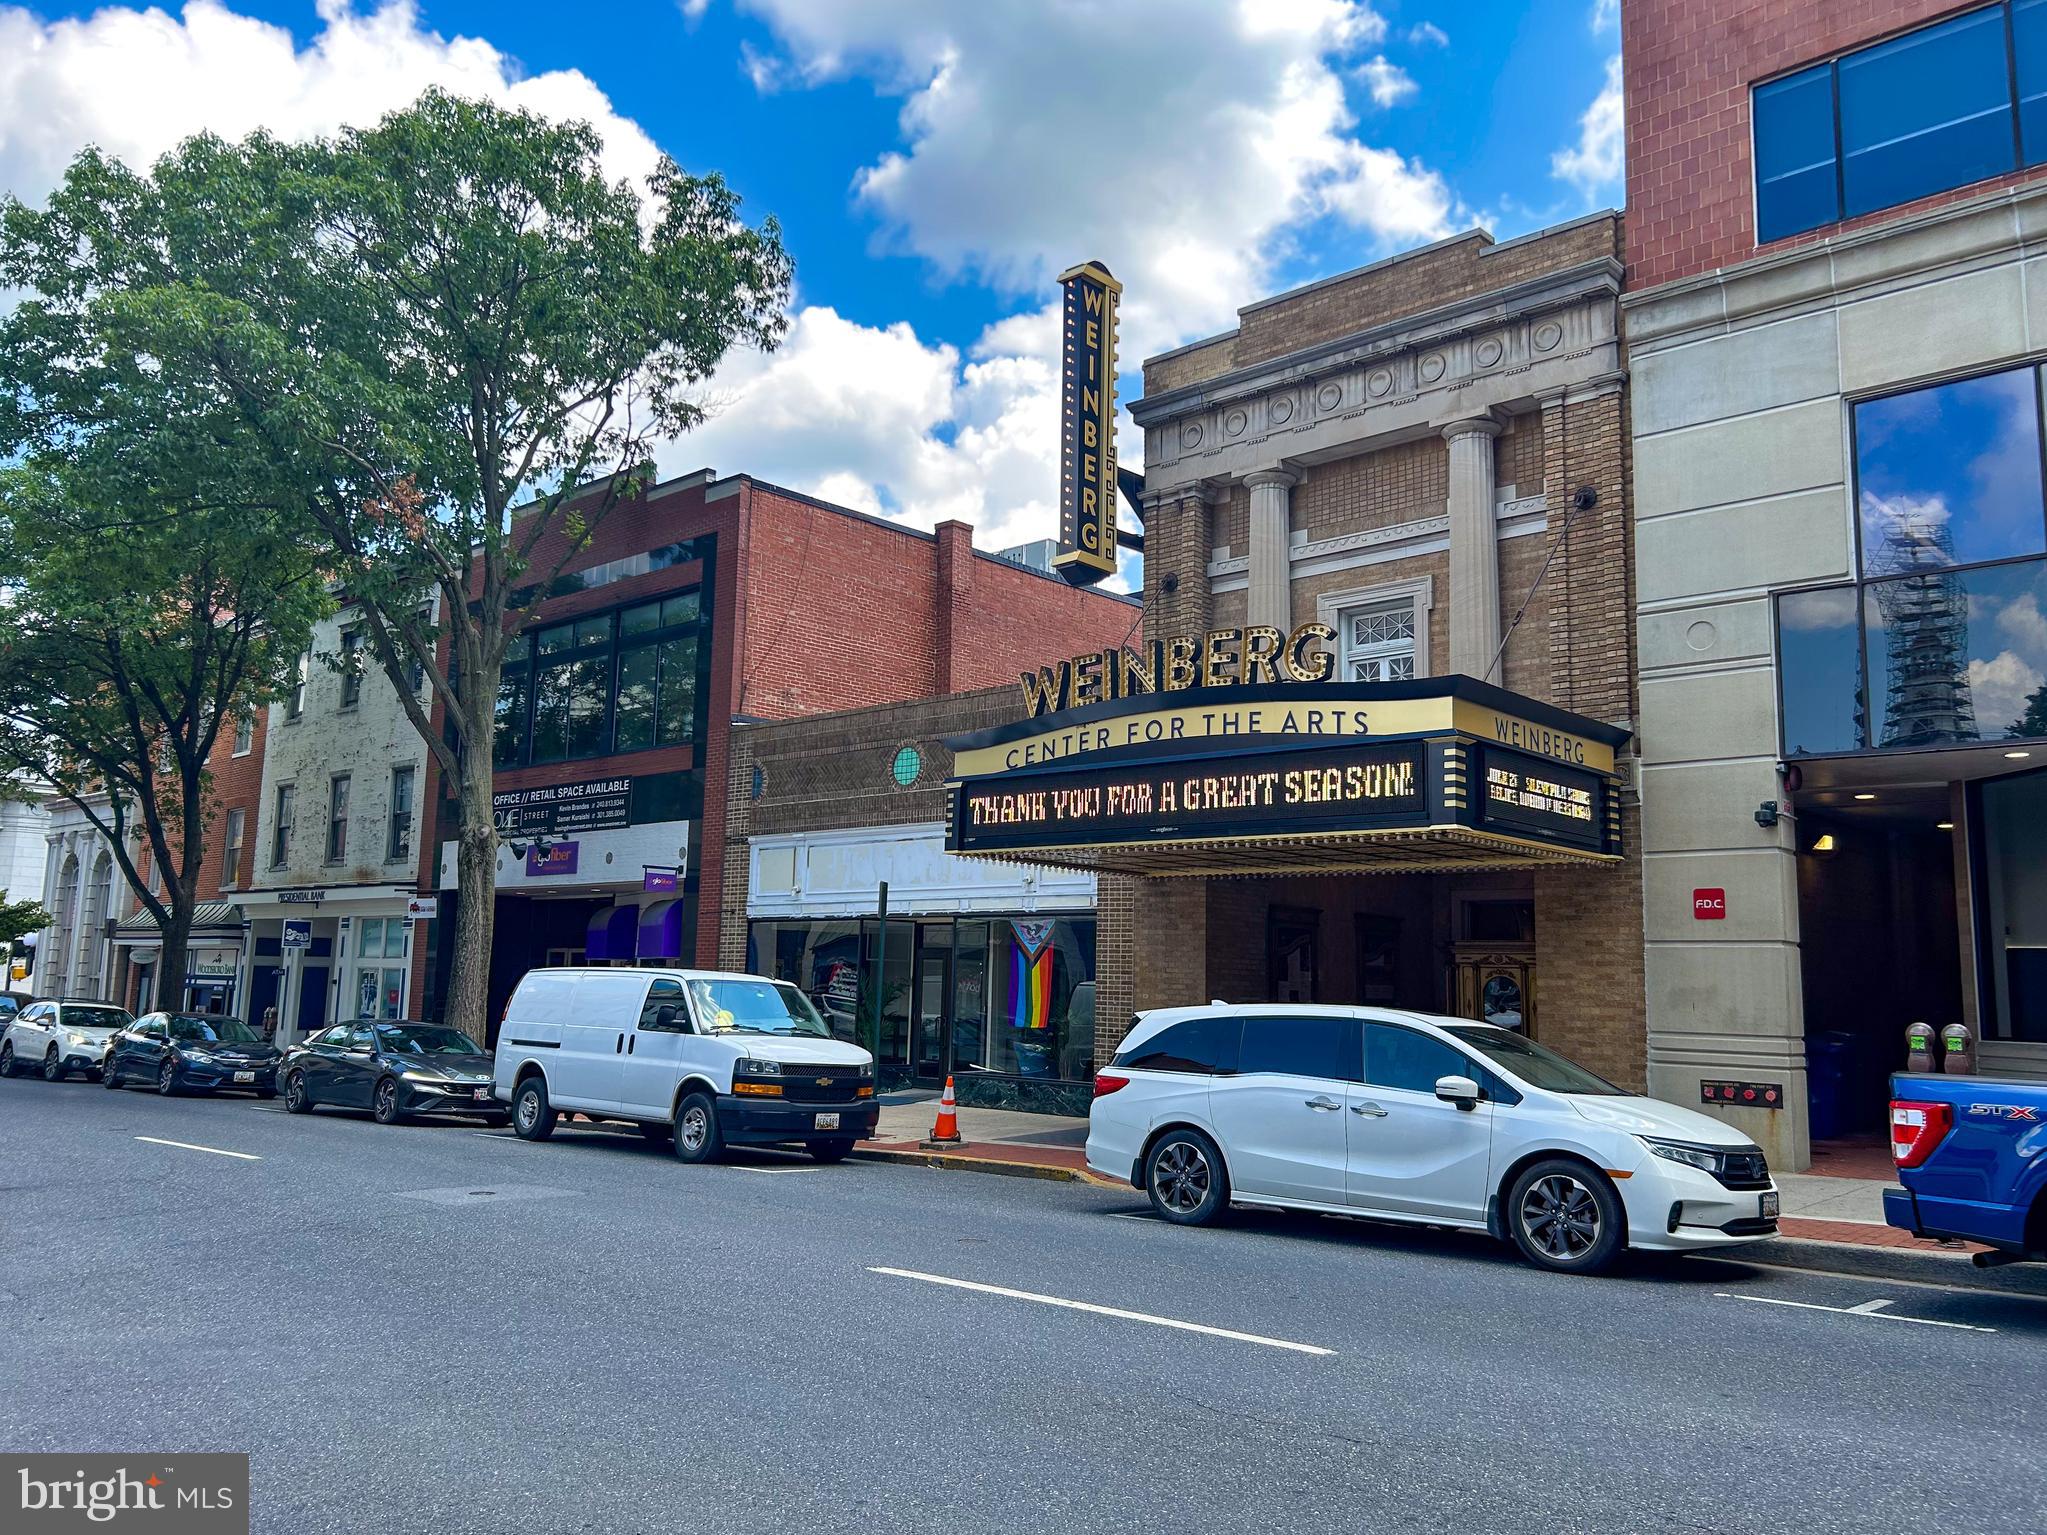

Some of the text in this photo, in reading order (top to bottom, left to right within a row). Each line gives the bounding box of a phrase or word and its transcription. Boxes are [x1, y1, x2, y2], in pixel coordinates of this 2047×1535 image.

[1082, 284, 1103, 550] WEINBERG
[1019, 622, 1337, 719] WEINBERG
[1006, 710, 1369, 769] CENTER FOR THE ARTS
[1495, 717, 1584, 764] WEINBERG
[494, 793, 520, 806] OFFICE
[530, 789, 556, 801] RETAIL
[558, 785, 584, 798] SPACE
[585, 779, 630, 795] AVAILABLE
[524, 810, 549, 821] STREET
[970, 791, 1047, 825] THANK
[1051, 787, 1100, 819] YOU
[1107, 783, 1153, 816] FOR
[1159, 781, 1178, 812] A
[1183, 773, 1279, 810] GREAT
[278, 890, 326, 902] PRESIDENTIAL BANK
[1968, 1103, 2040, 1121] STX
